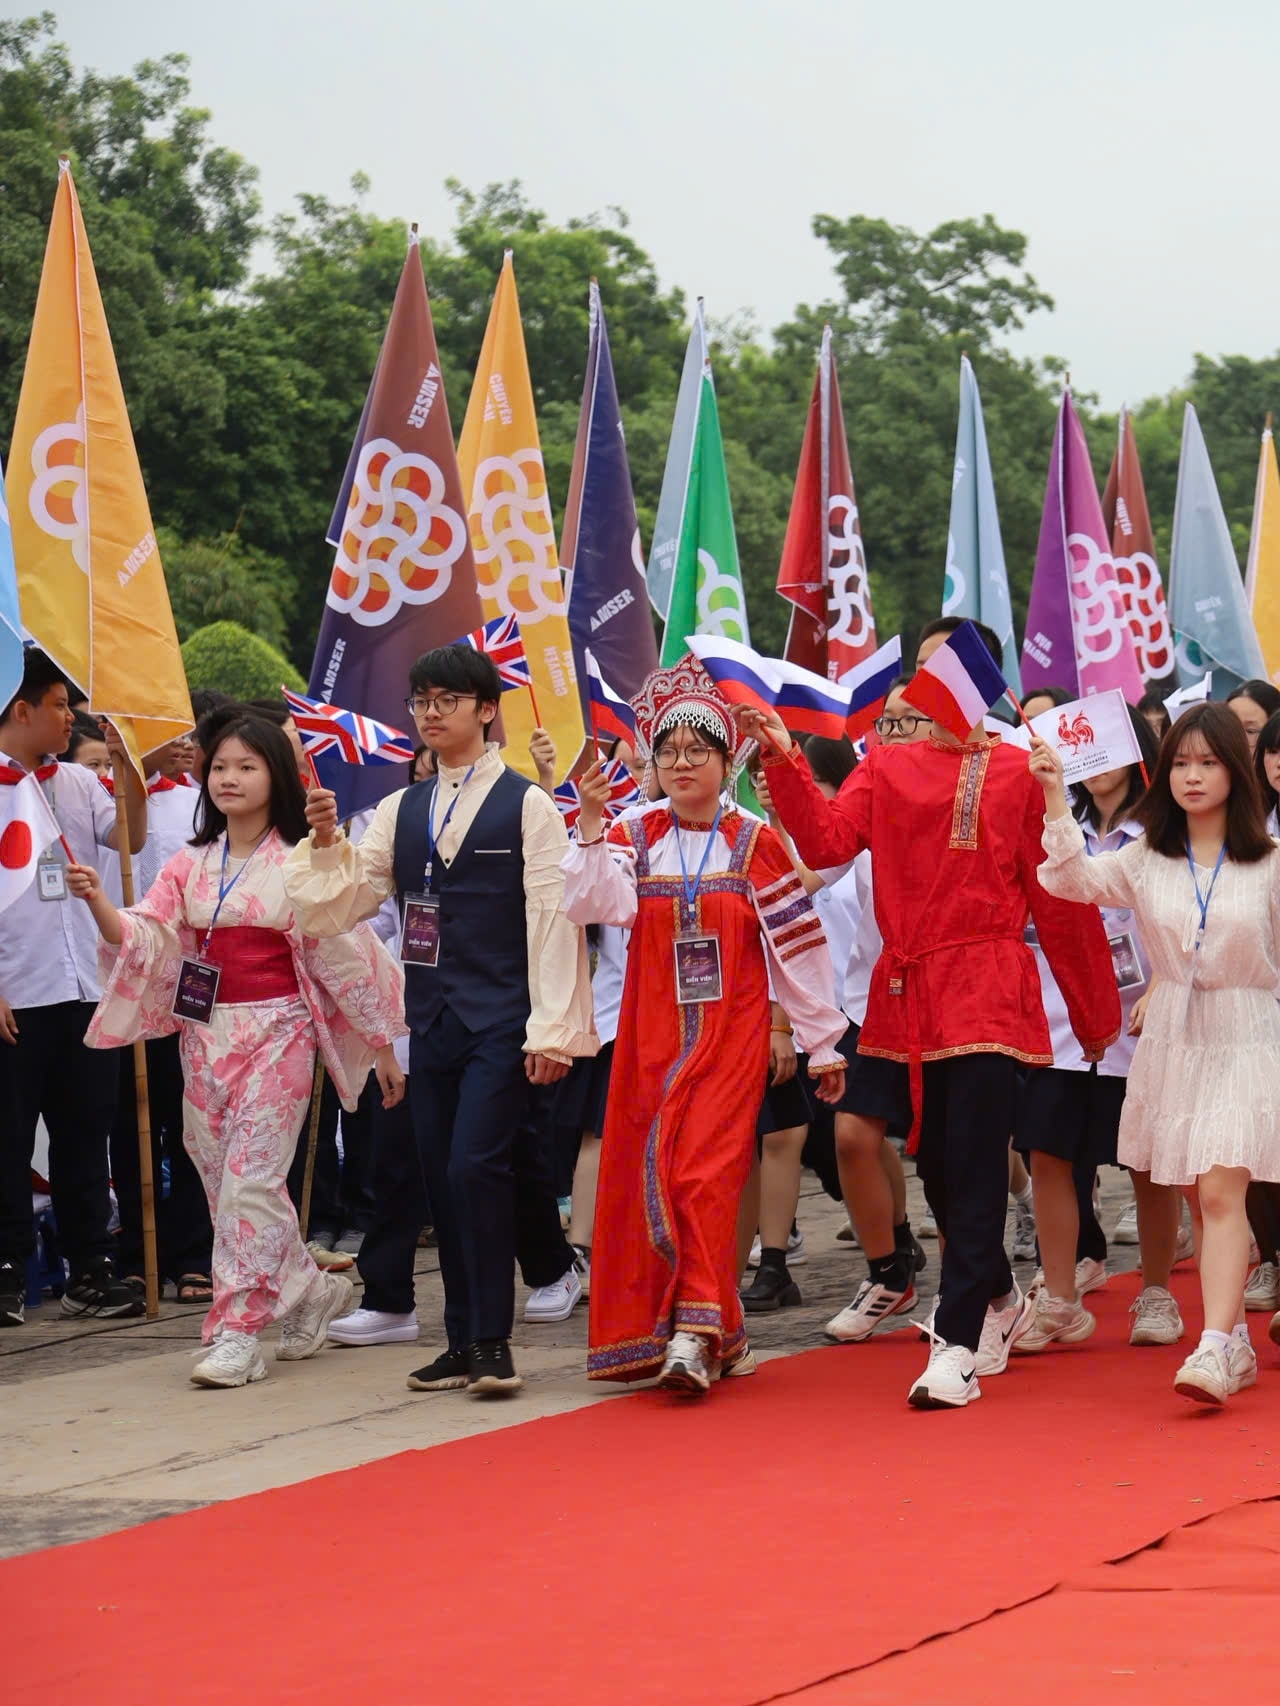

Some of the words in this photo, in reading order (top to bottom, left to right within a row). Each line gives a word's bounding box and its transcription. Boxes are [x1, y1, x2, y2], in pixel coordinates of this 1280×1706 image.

[407, 362, 441, 429] AMSER
[117, 531, 157, 588] AMSER
[590, 588, 635, 632] AMSER
[320, 638, 346, 704] AMSER
